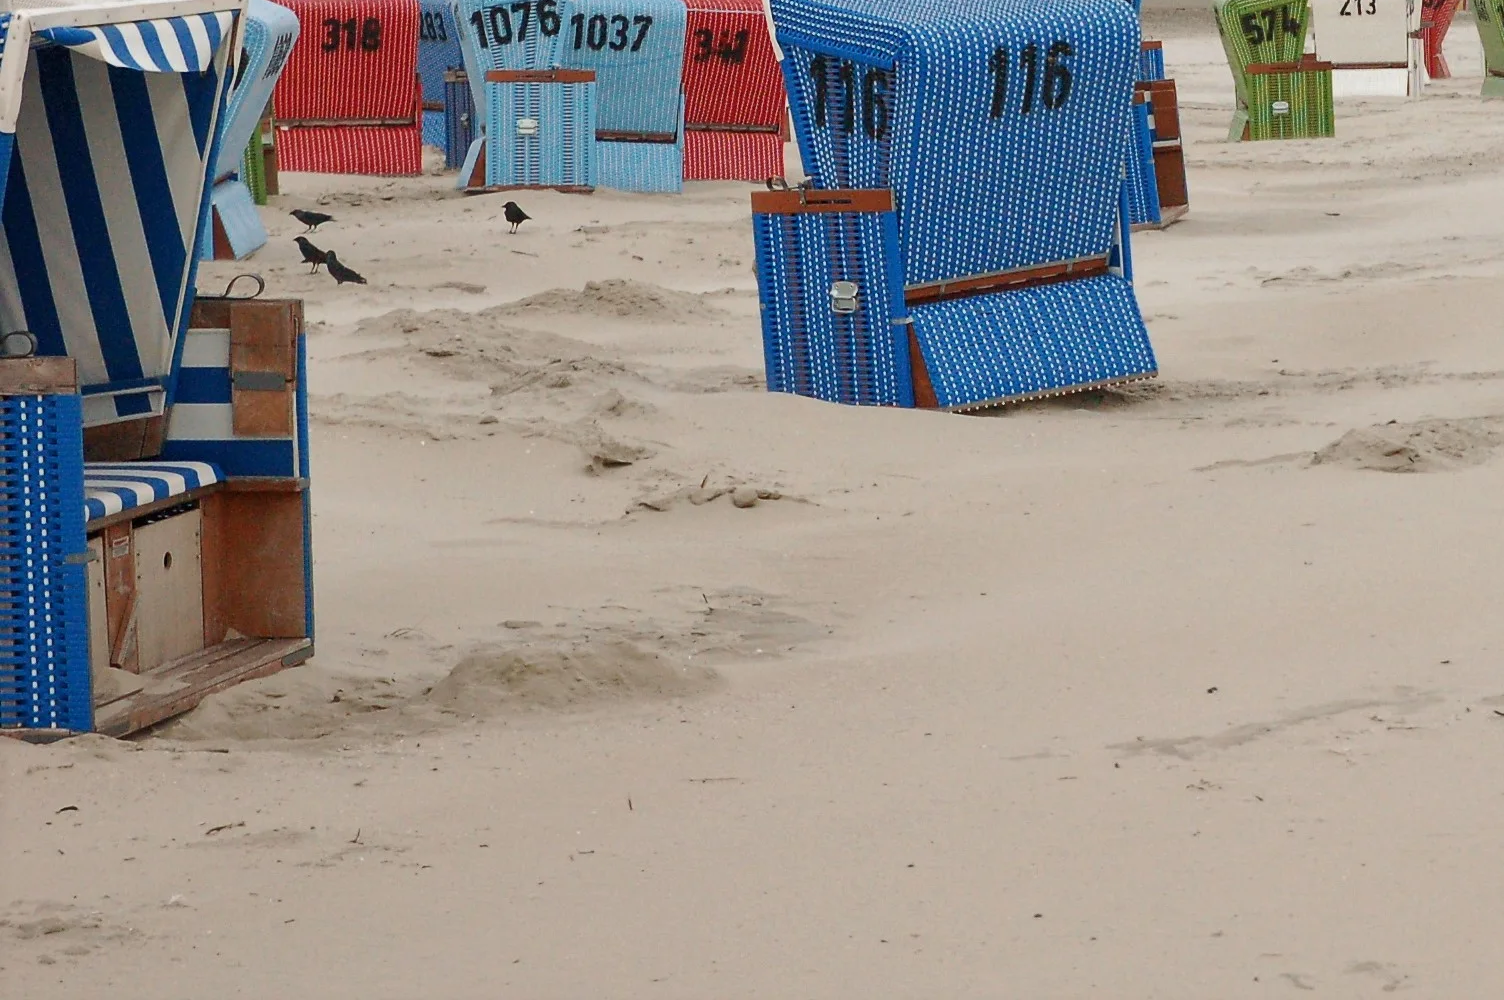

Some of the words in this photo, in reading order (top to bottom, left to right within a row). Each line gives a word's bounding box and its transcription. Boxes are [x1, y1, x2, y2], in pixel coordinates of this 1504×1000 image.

[321, 16, 382, 53] 318
[570, 13, 654, 51] 1037
[1241, 5, 1301, 45] 574
[809, 53, 891, 142] 116
[987, 40, 1076, 119] 116
